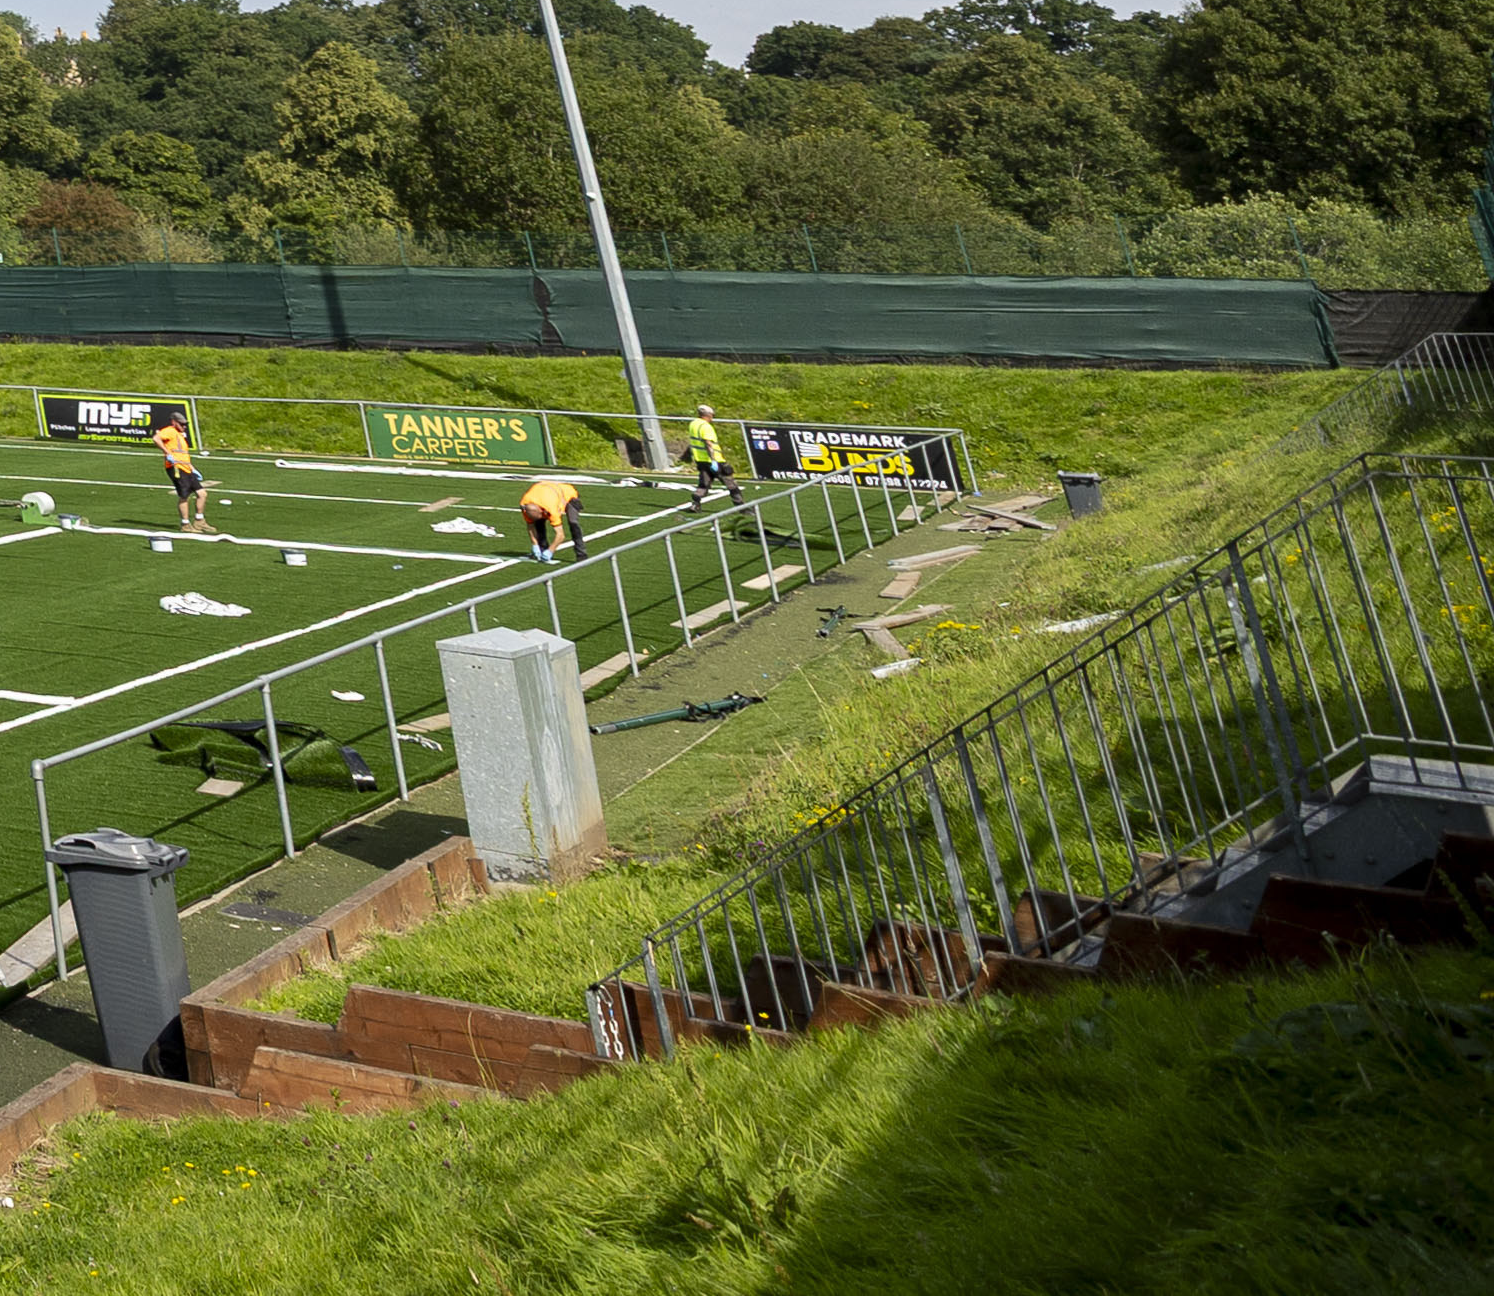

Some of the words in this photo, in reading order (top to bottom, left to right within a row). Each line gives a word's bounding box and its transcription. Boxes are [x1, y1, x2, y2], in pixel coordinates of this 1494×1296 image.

[50, 424, 76, 432] Pitches
[85, 426, 111, 434] Leagues
[383, 413, 528, 442] TANNER'S
[392, 436, 489, 457] CARPETS
[789, 431, 908, 449] TRADEMARK
[865, 475, 902, 487] 0798
